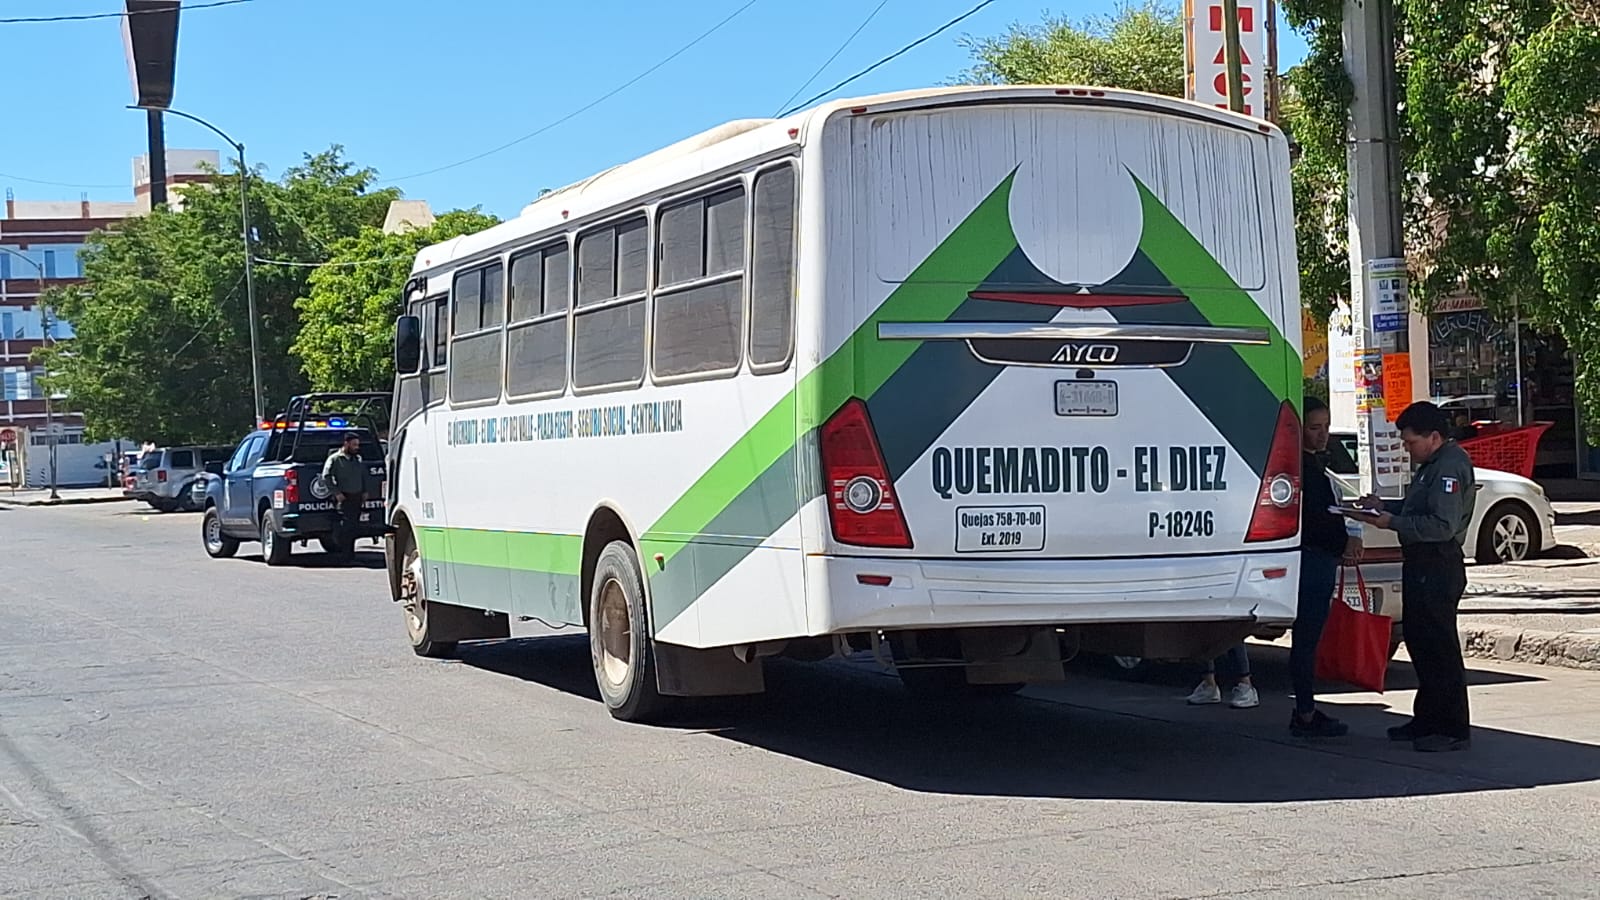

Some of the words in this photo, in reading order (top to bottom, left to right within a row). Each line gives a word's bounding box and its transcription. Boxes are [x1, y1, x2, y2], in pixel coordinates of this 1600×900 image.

[1050, 343, 1119, 362] AYCO
[537, 411, 555, 441] PLAZA
[555, 410, 574, 440] FIESTA
[577, 407, 602, 438] SEGURO
[603, 405, 627, 437] SOCIAL
[631, 402, 661, 435] CENTRAL
[662, 399, 683, 432] VIEJA
[370, 466, 385, 476] SA
[932, 446, 1110, 500] QUEMADITO
[1134, 446, 1165, 492] EL
[1169, 446, 1228, 492] DIEZ
[300, 500, 335, 511] POLICÍA
[961, 512, 995, 528] Quejas
[996, 511, 1042, 527] 758-70-00
[1149, 510, 1215, 538] P-18246
[981, 532, 998, 546] Ext.
[999, 531, 1022, 546] 2019
